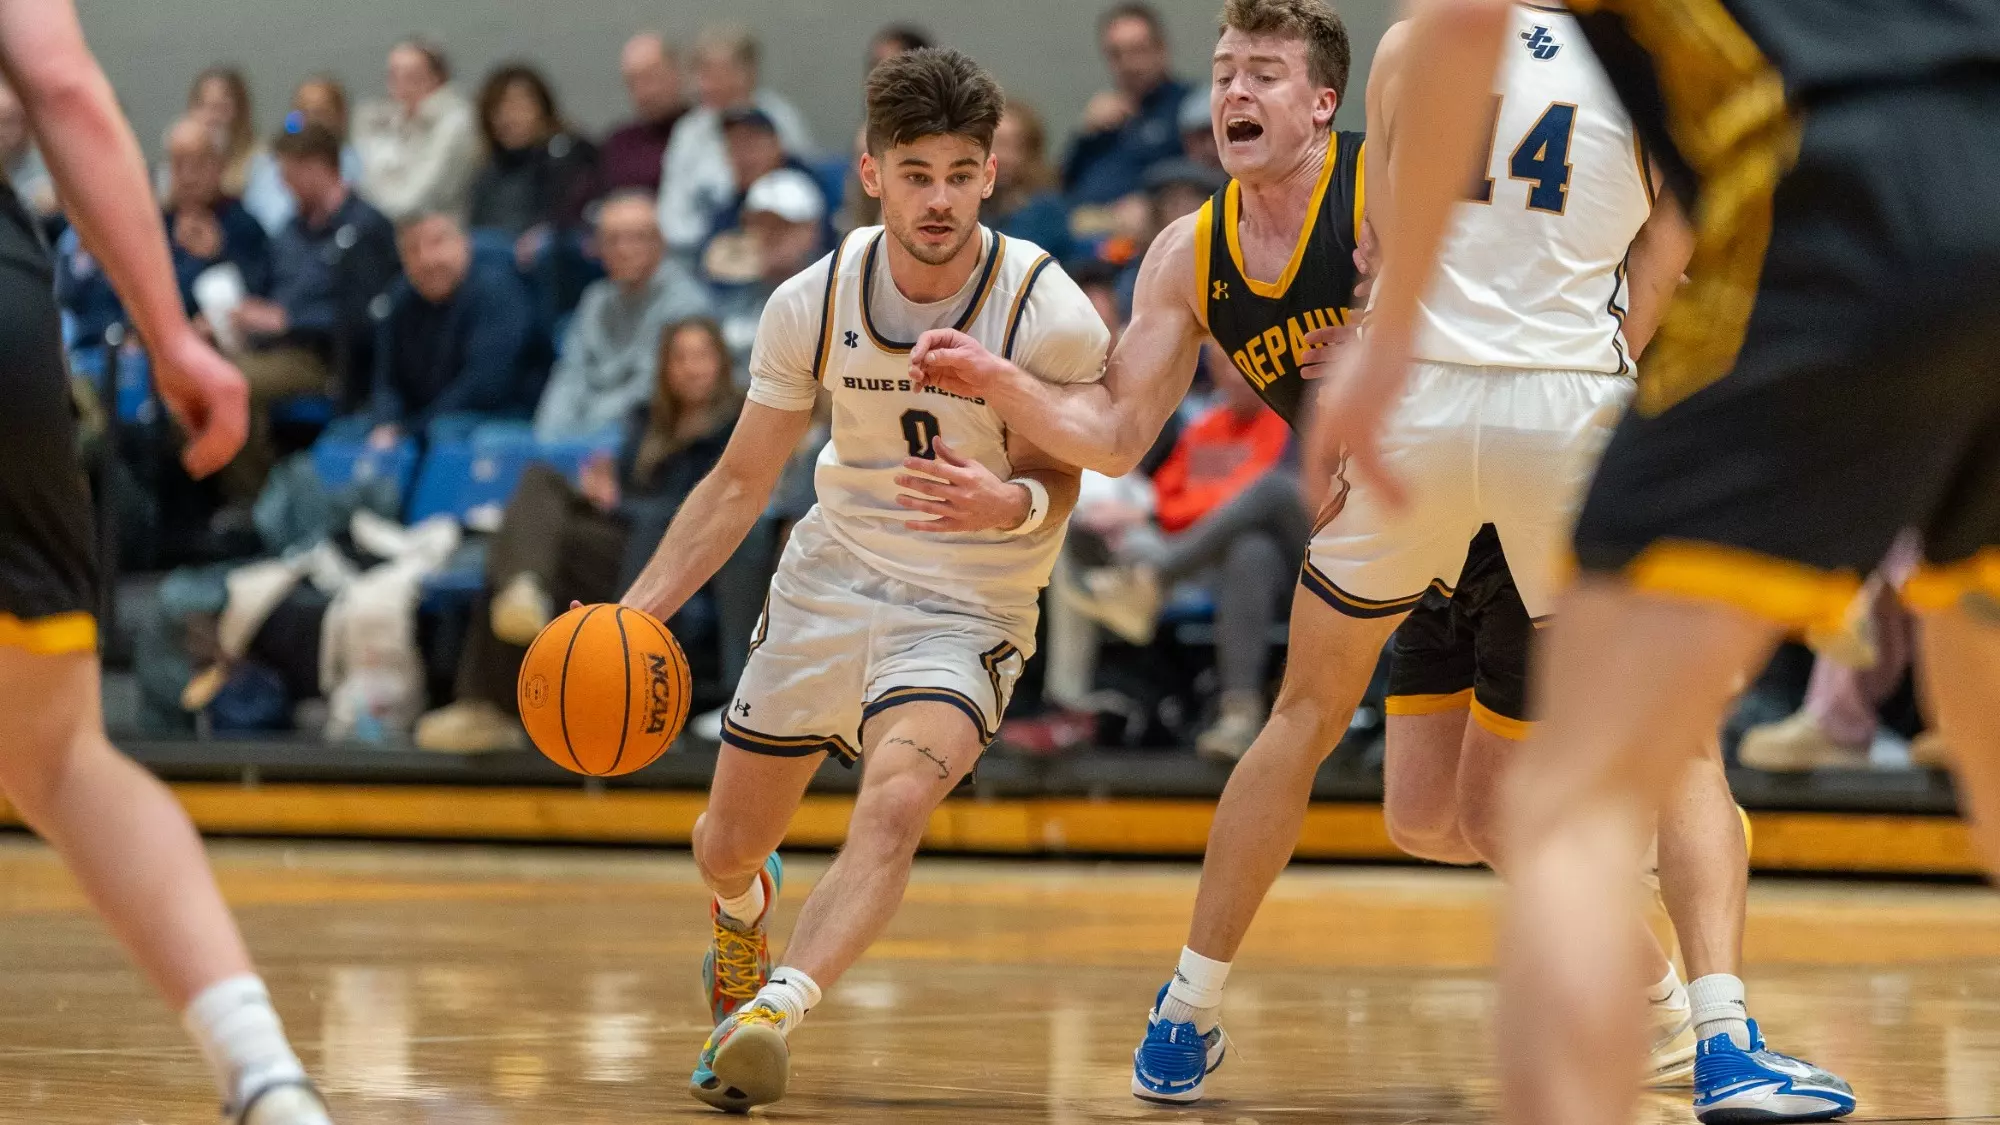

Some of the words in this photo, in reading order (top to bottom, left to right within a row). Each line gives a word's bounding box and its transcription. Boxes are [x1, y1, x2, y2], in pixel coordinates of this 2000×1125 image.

[1519, 25, 1562, 61] JCU
[843, 377, 894, 391] BLUE
[901, 409, 940, 460] 0
[646, 653, 669, 734] NCAA
